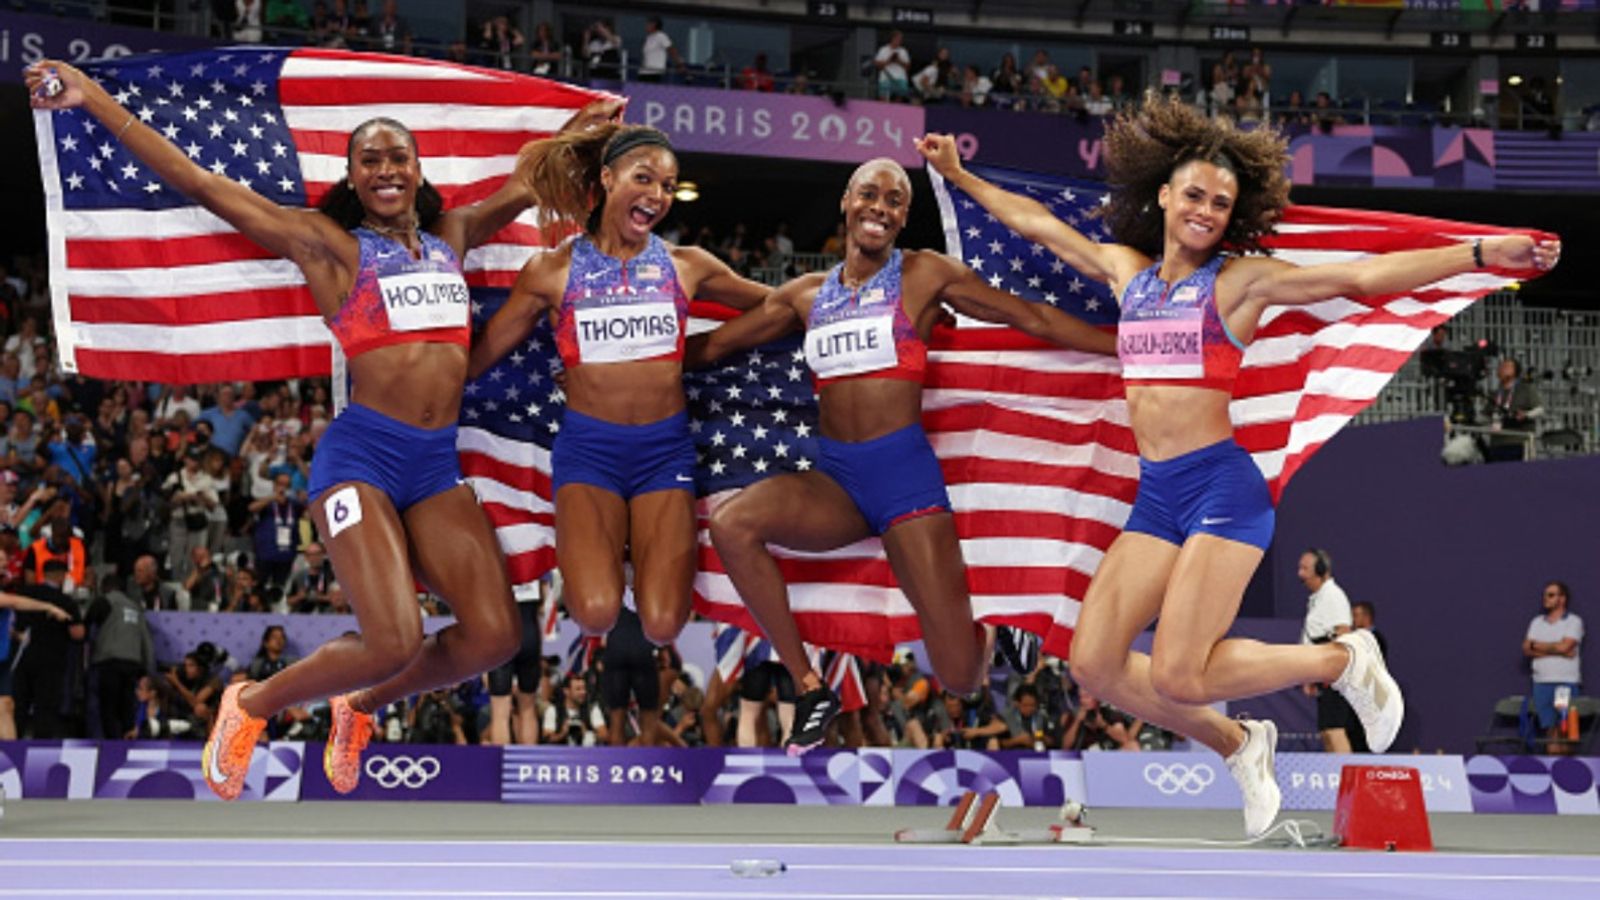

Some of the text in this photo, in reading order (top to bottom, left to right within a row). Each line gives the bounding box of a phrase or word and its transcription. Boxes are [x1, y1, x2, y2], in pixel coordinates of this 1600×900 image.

[645, 102, 904, 148] PARIS 2024
[386, 283, 468, 309] HOLMES
[579, 313, 677, 342] THOMAS
[816, 327, 879, 358] LITTLE
[334, 498, 349, 524] 6
[518, 764, 684, 785] PARIS 2024
[1291, 771, 1454, 792] PAR 24
[1375, 769, 1412, 781] OMEGA
